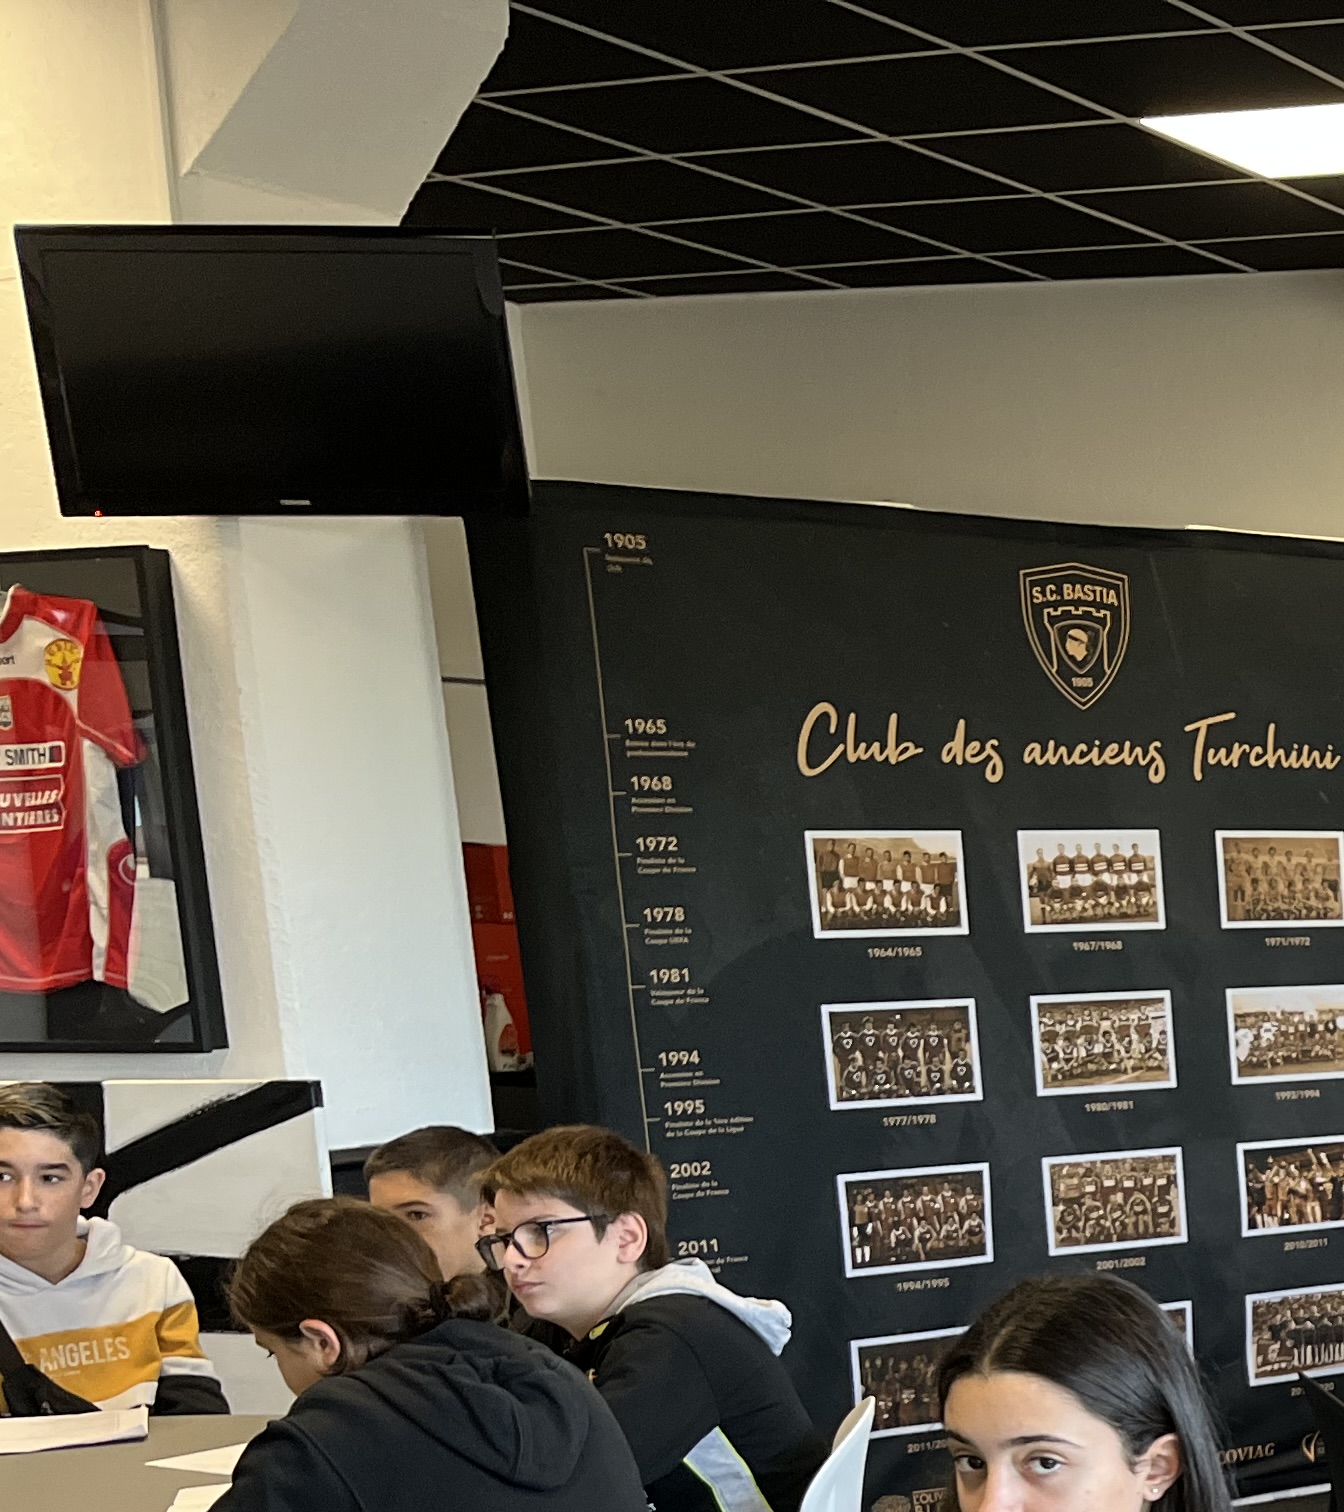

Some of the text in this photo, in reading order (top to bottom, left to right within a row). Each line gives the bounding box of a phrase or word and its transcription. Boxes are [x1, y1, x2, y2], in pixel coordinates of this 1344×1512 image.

[604, 532, 647, 550] 1905
[1031, 583, 1119, 607] S.C. BASTIA
[624, 718, 667, 735] 1965
[797, 701, 1342, 785] Club des anciens Turchini
[4, 745, 47, 767] SMITH
[630, 775, 673, 791] 1968
[635, 836, 679, 852] 1972
[643, 906, 685, 922] 1978
[866, 946, 923, 959] 1964/1965
[649, 967, 691, 984] 1981
[658, 1049, 701, 1066] 1994
[664, 1099, 706, 1117] 1995
[669, 1160, 712, 1179] 2002
[677, 1238, 719, 1257] 2011
[40, 1336, 131, 1373] ANGELES
